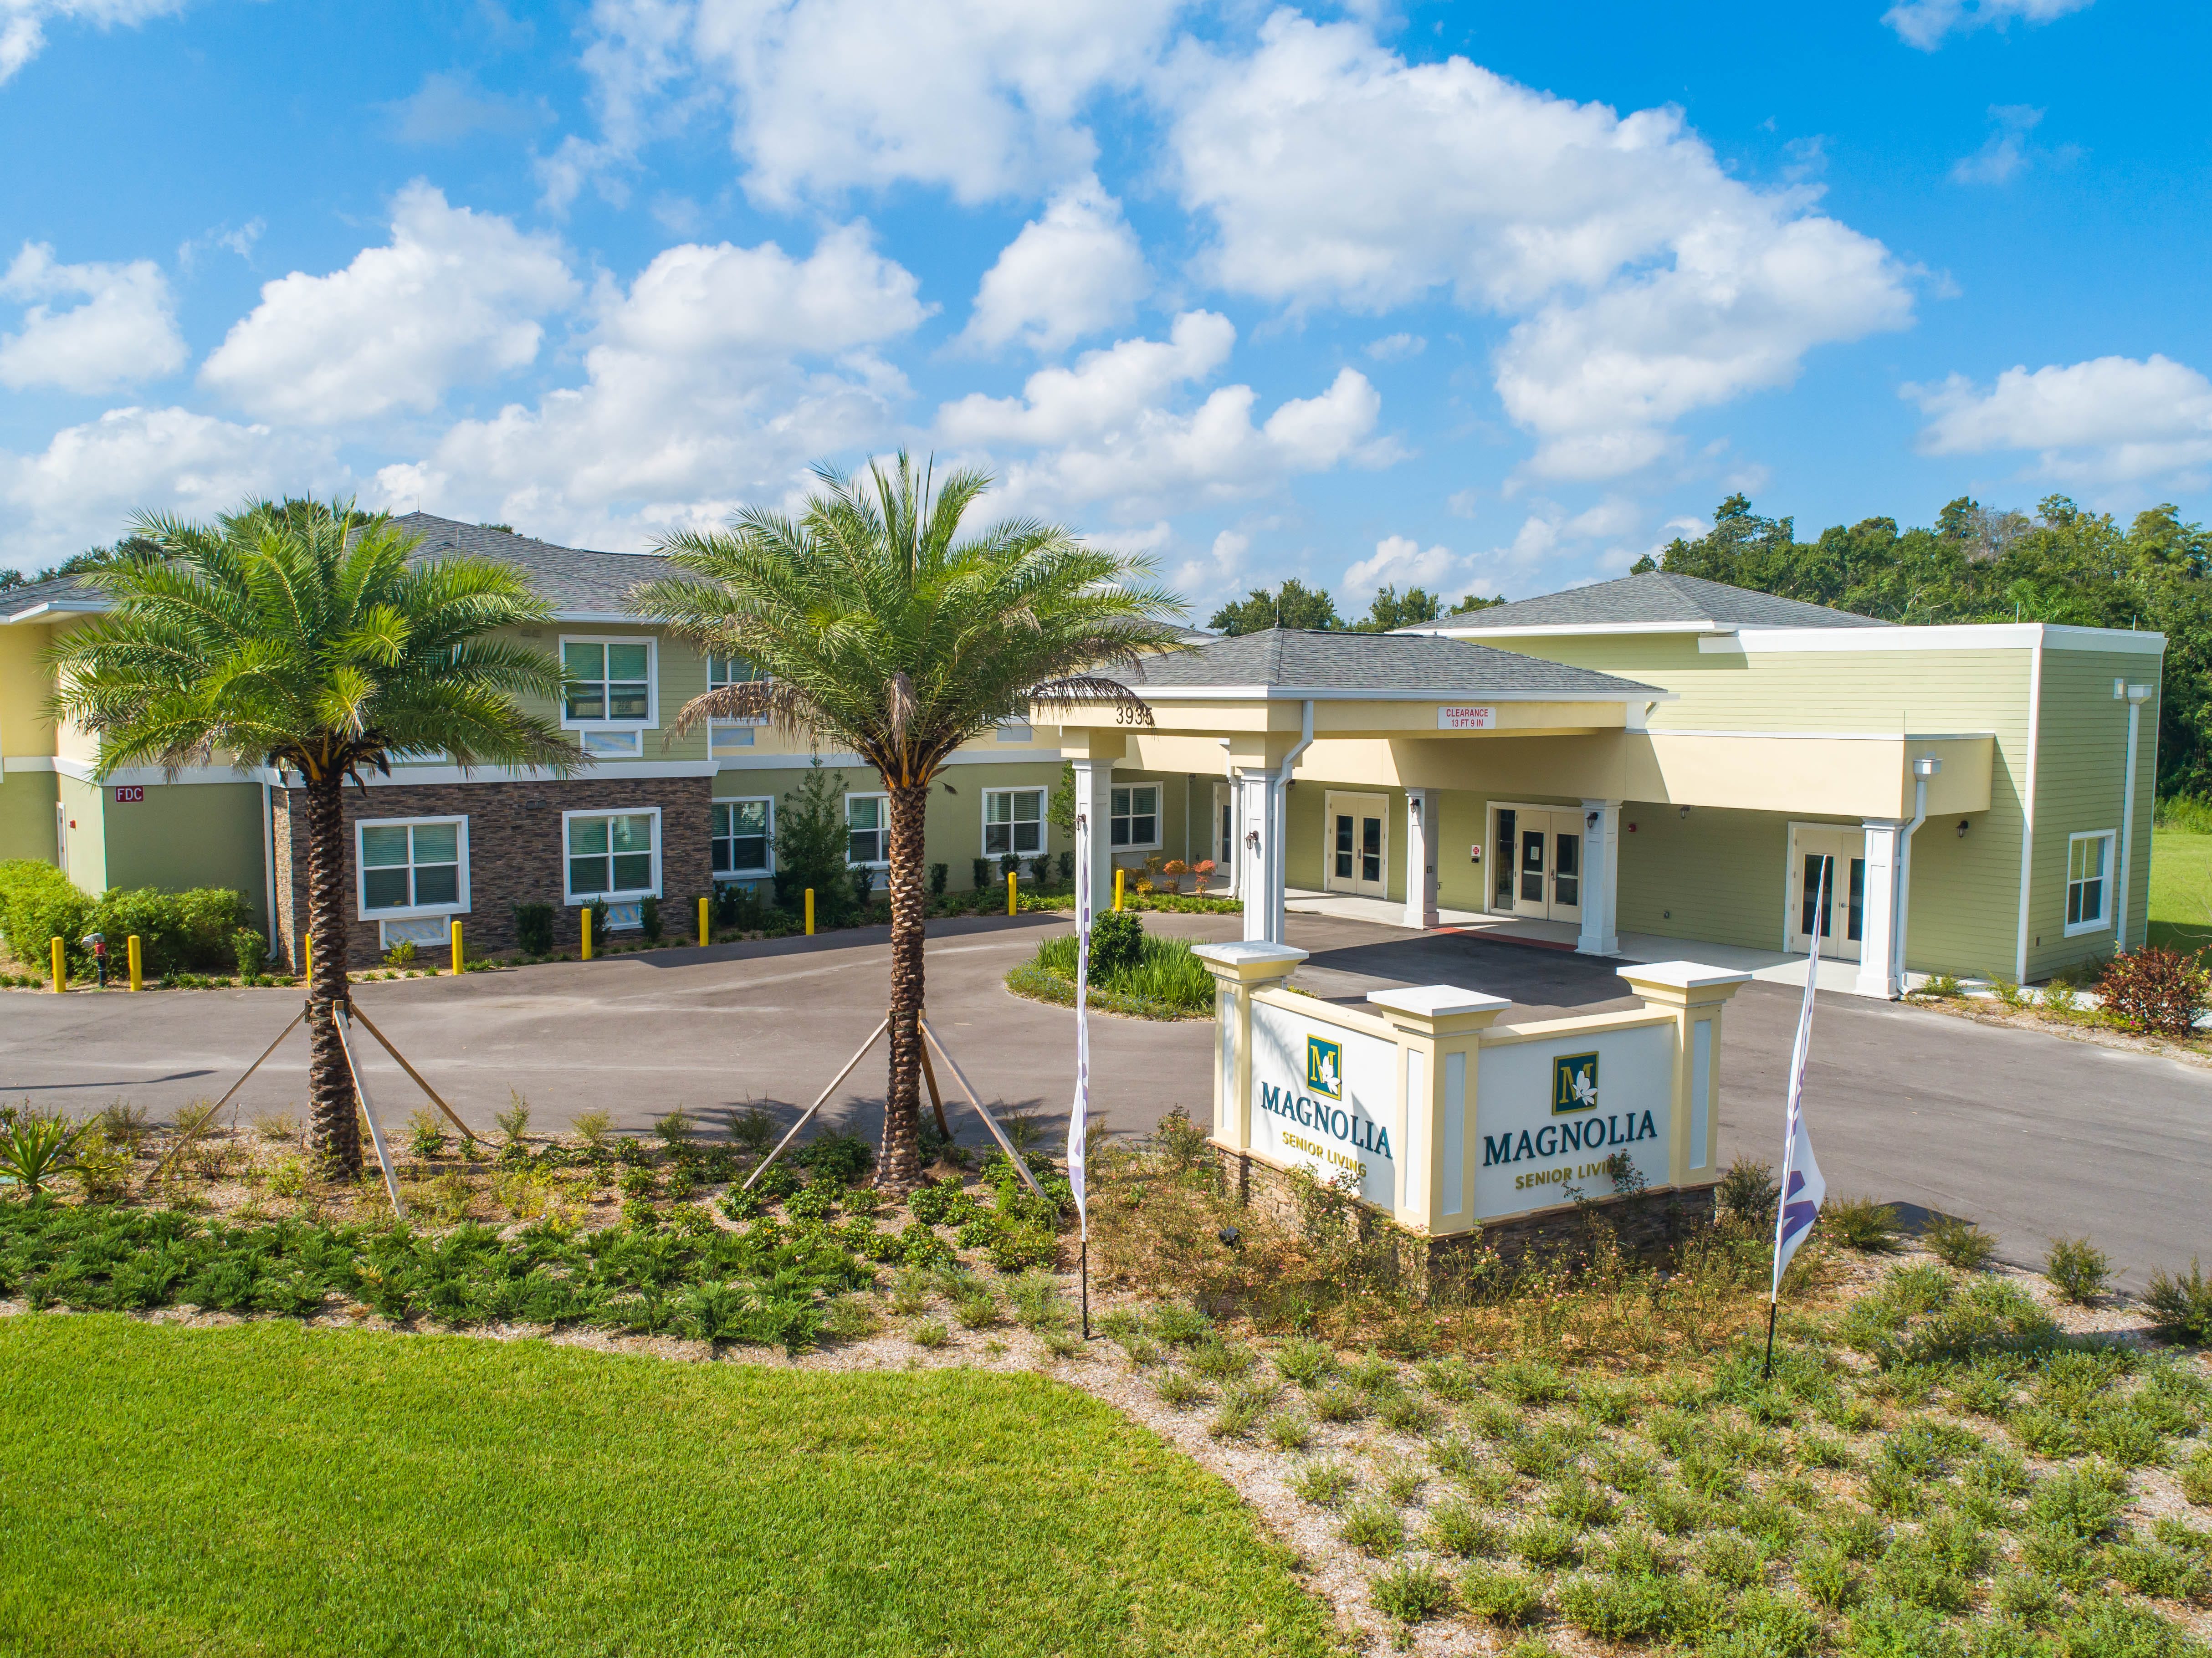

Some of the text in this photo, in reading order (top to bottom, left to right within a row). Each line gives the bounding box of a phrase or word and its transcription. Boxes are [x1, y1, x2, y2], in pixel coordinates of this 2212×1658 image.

[1116, 706, 1152, 725] 3935
[1446, 709, 1488, 717] CLEARANCE
[117, 788, 142, 800] FDC
[1261, 1081, 1393, 1160] MAGNOLIA
[1282, 1131, 1367, 1177] SENIOR LIVING
[1483, 1110, 1658, 1166] MAGNOLIA
[1516, 1157, 1616, 1190] SENIOR LIVI
